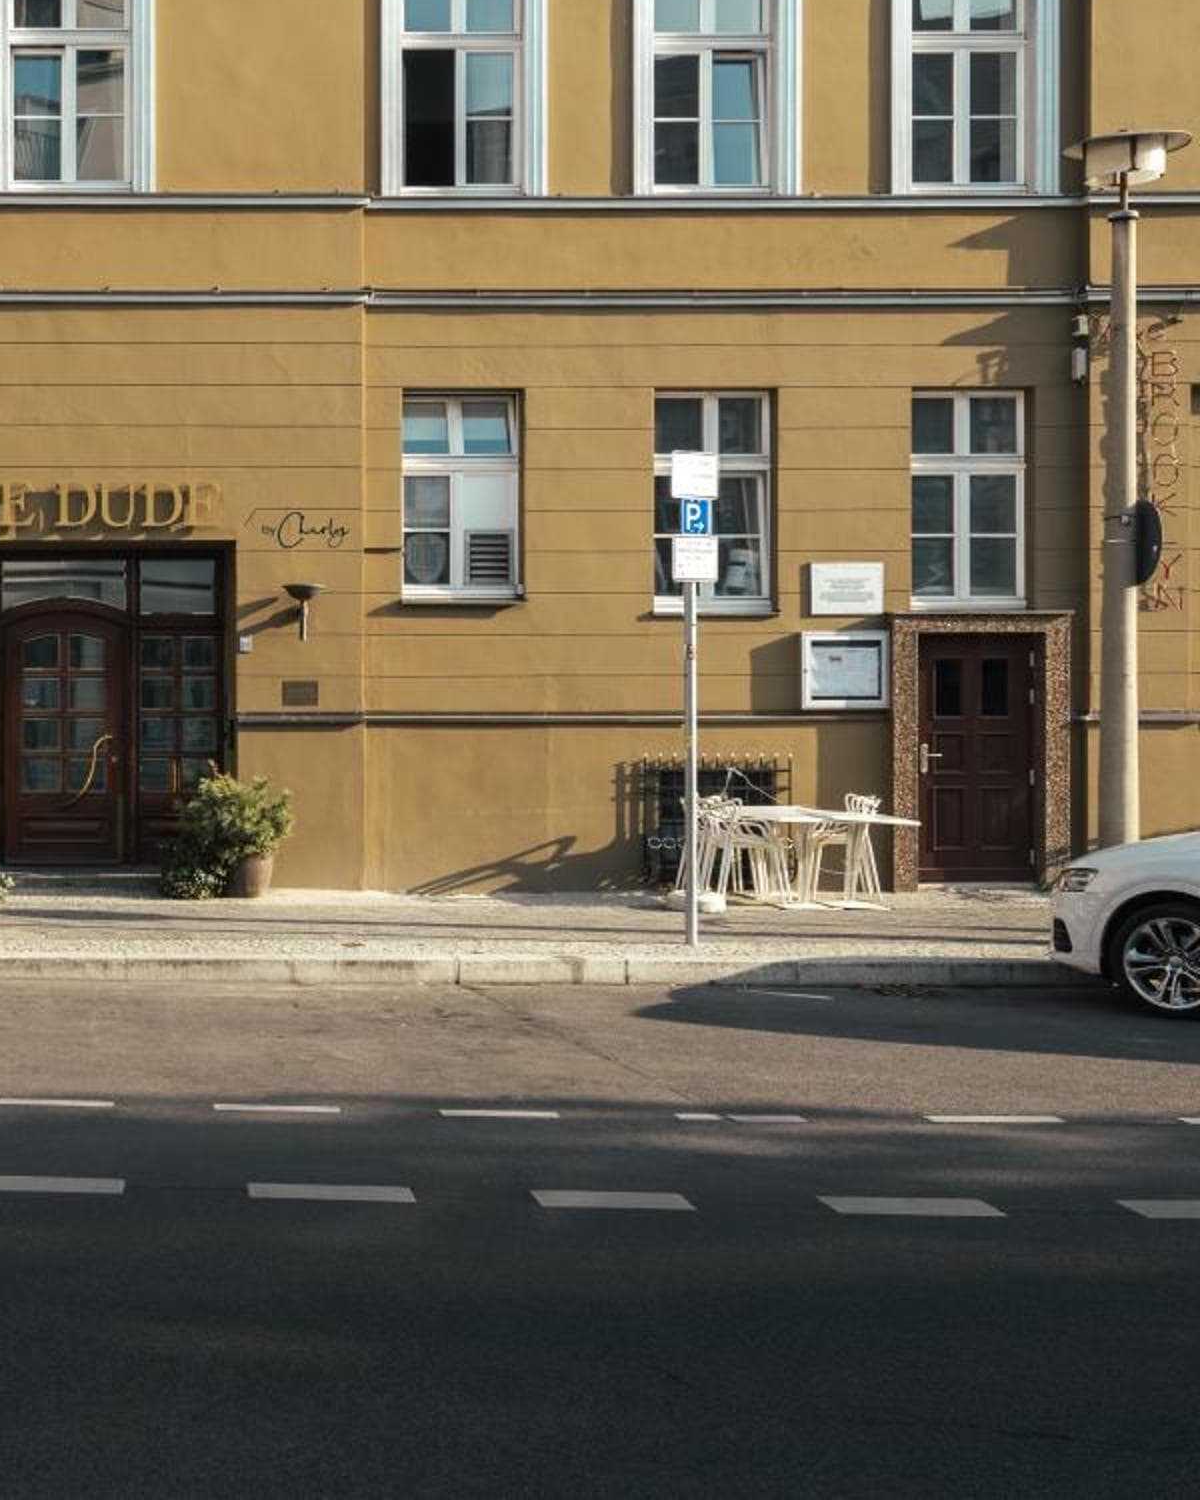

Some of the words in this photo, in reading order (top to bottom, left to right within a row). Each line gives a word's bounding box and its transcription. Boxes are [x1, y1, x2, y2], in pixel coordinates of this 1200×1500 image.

[1151, 351, 1183, 611] BROOKYN
[54, 483, 222, 529] DUDE
[686, 503, 702, 532] P
